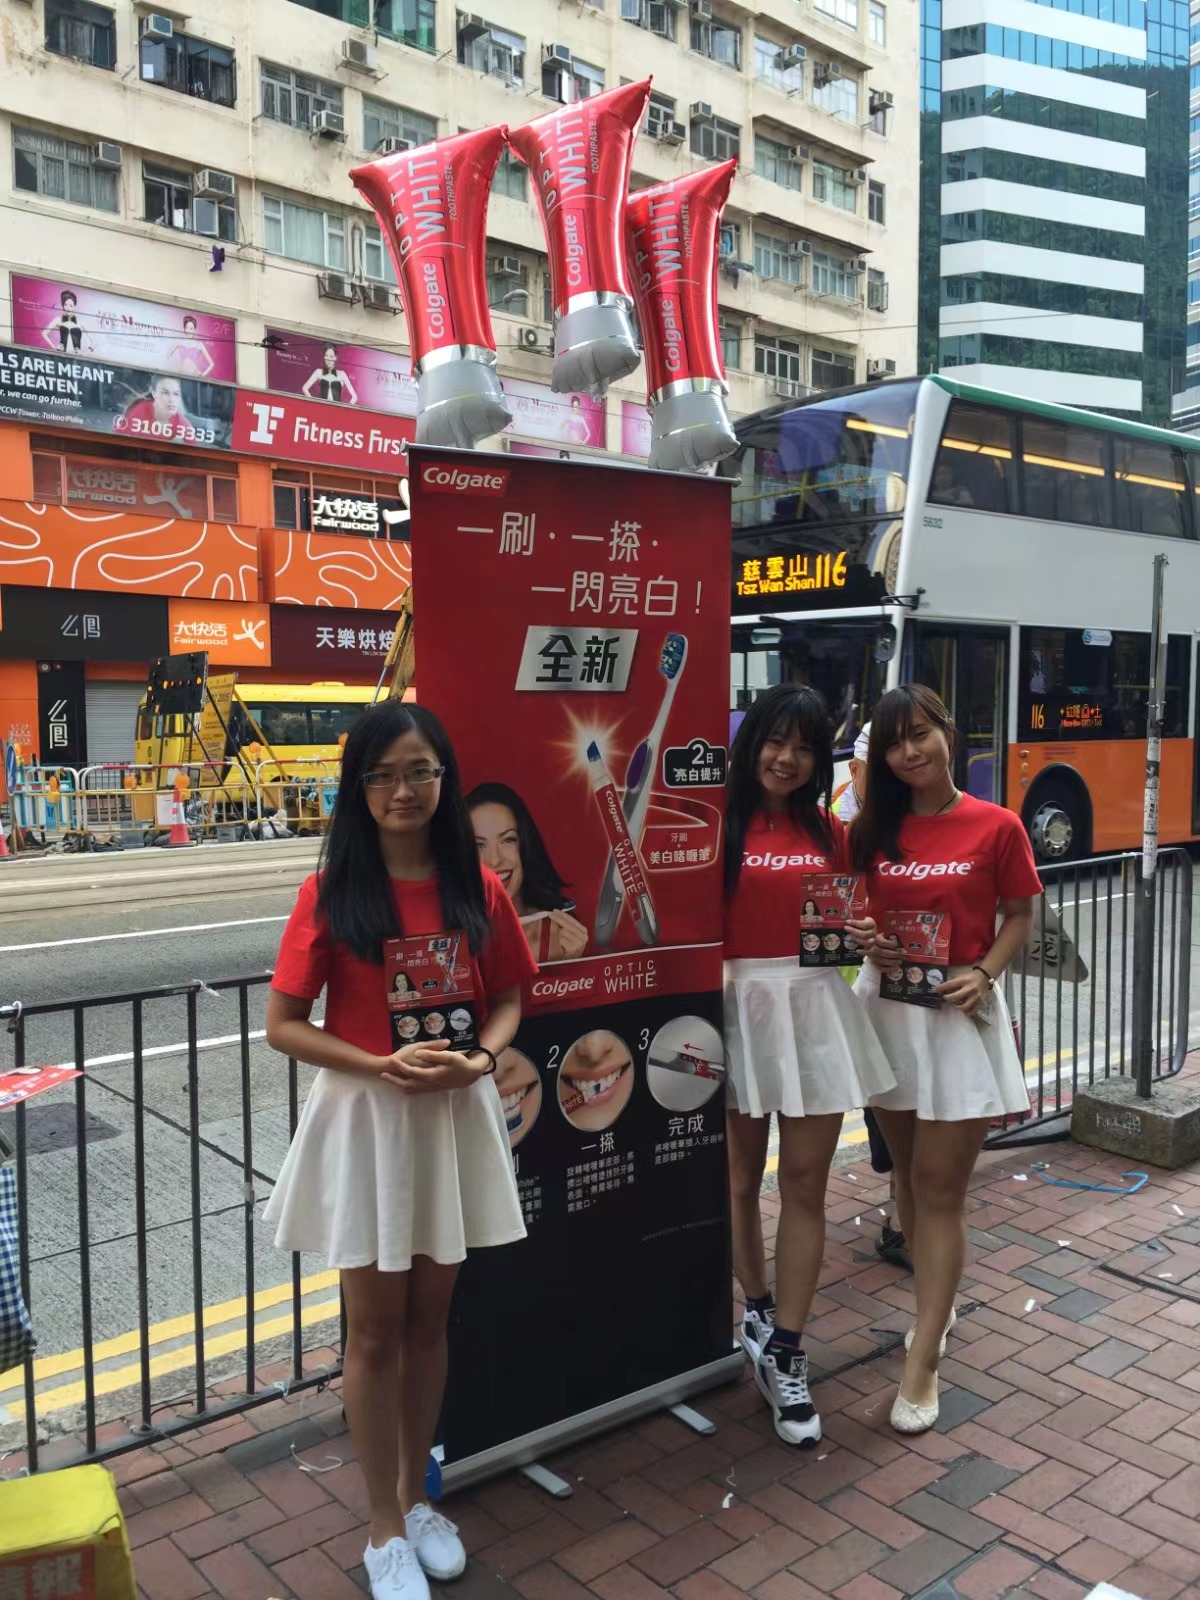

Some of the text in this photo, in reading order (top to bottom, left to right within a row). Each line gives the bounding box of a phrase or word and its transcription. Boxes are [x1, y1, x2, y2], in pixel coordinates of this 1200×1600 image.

[566, 214, 584, 287] Colgate
[422, 263, 446, 340] Colgate
[664, 301, 683, 372] Colgate
[22, 356, 55, 374] ARE
[58, 362, 114, 384] MEANT
[14, 371, 83, 395] BEATEN.
[8, 390, 21, 398] we
[22, 392, 37, 401] can
[38, 396, 49, 404] go
[50, 395, 83, 408] further.
[130, 418, 215, 445] 3106 3333
[294, 416, 364, 449] Fitness
[423, 467, 503, 490] Colgate
[313, 495, 379, 521] 大快活
[313, 516, 379, 532] Fairwood
[743, 551, 847, 588] 慈雲山 116
[736, 576, 815, 595] Tsz Wan Shan
[174, 620, 227, 637] 大快活
[174, 636, 228, 645] Fairwood
[536, 634, 620, 683] 全新
[1031, 703, 1045, 729] 116
[691, 743, 714, 765] 2日
[674, 768, 721, 782] 亮白提升
[605, 790, 623, 833] Colgate
[614, 842, 639, 896] WHITE
[878, 861, 972, 880] Colgate
[604, 960, 655, 977] OPTIC
[532, 976, 595, 997] Colgate
[605, 972, 656, 994] WHITE
[638, 1028, 650, 1050] 3
[547, 1045, 560, 1069] 2
[668, 1114, 704, 1136] 完成
